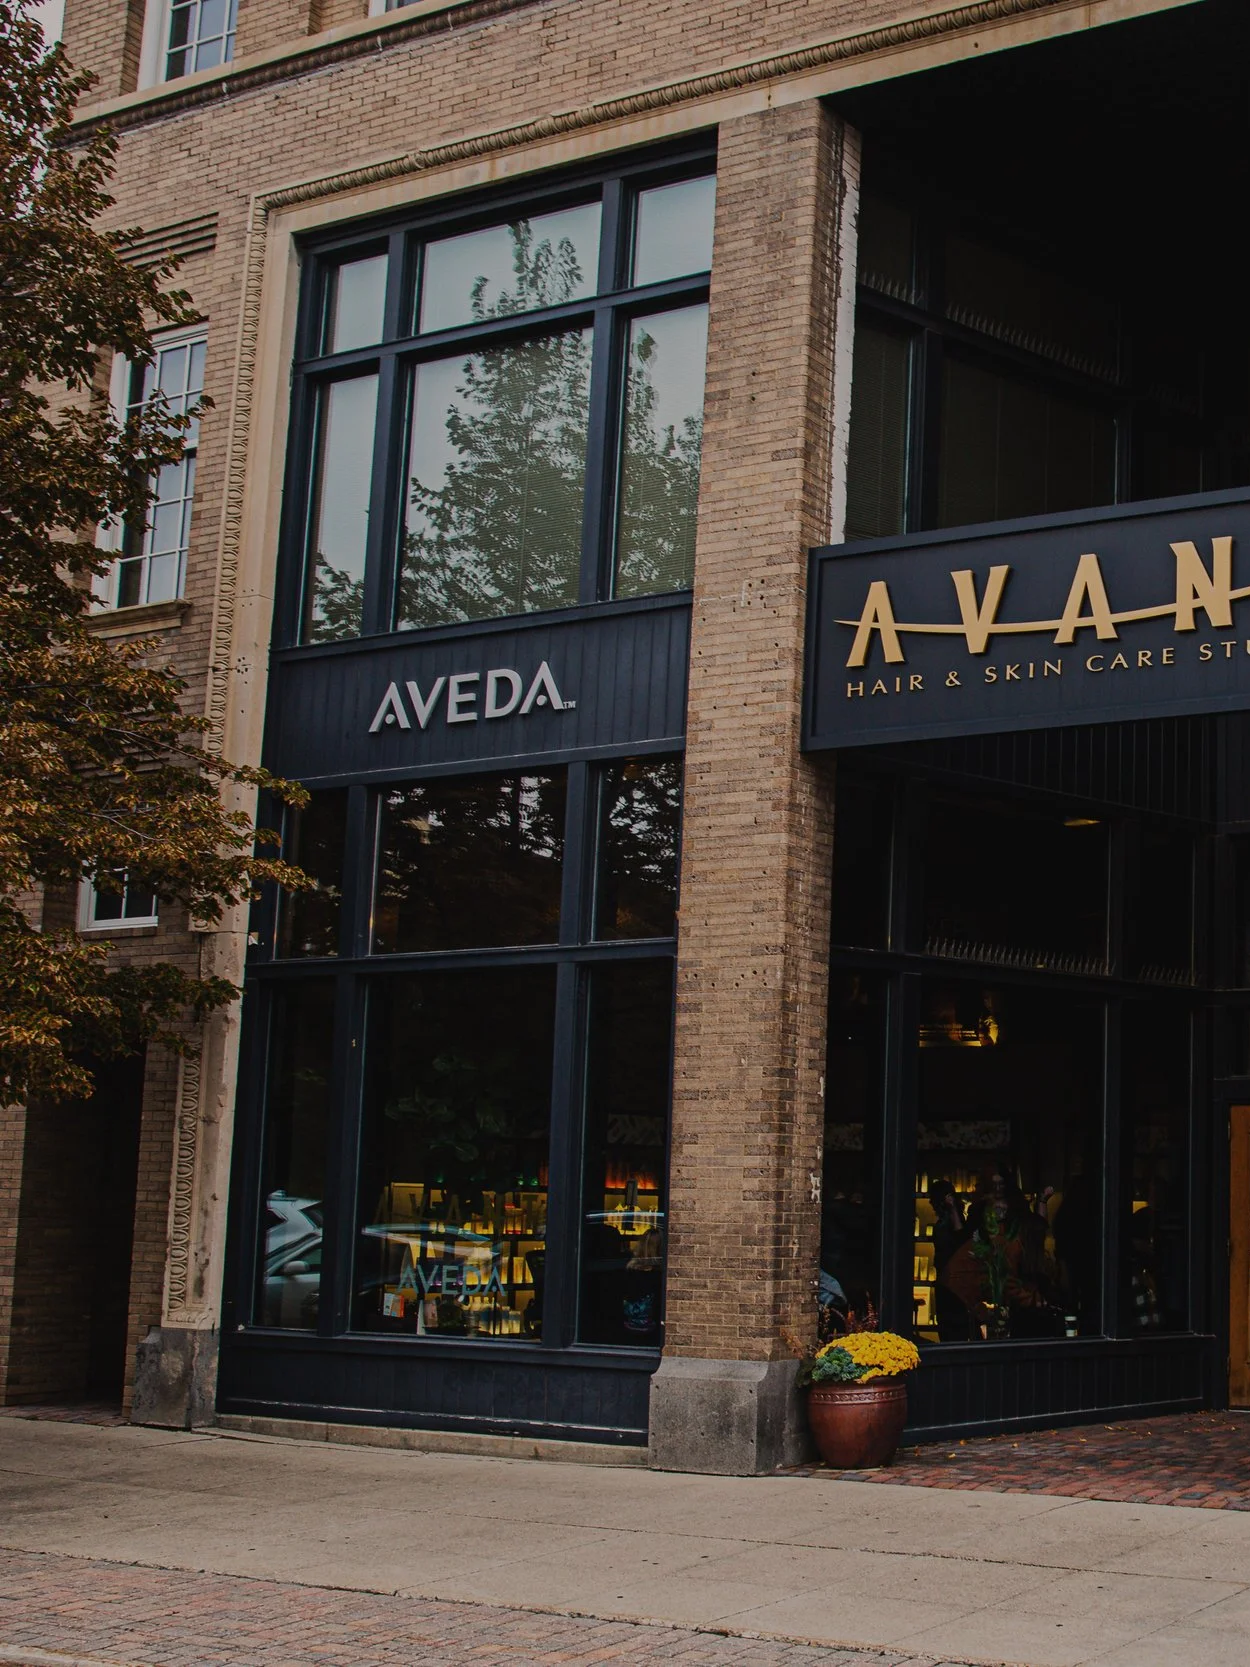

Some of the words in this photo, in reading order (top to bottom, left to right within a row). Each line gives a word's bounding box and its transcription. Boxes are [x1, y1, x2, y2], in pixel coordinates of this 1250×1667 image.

[368, 660, 564, 733] AVEDA
[846, 673, 925, 698] HAIR
[945, 670, 962, 687] &
[984, 658, 1063, 683] SKIN
[1086, 647, 1176, 673] CARE
[398, 1263, 506, 1297] AVEDA
